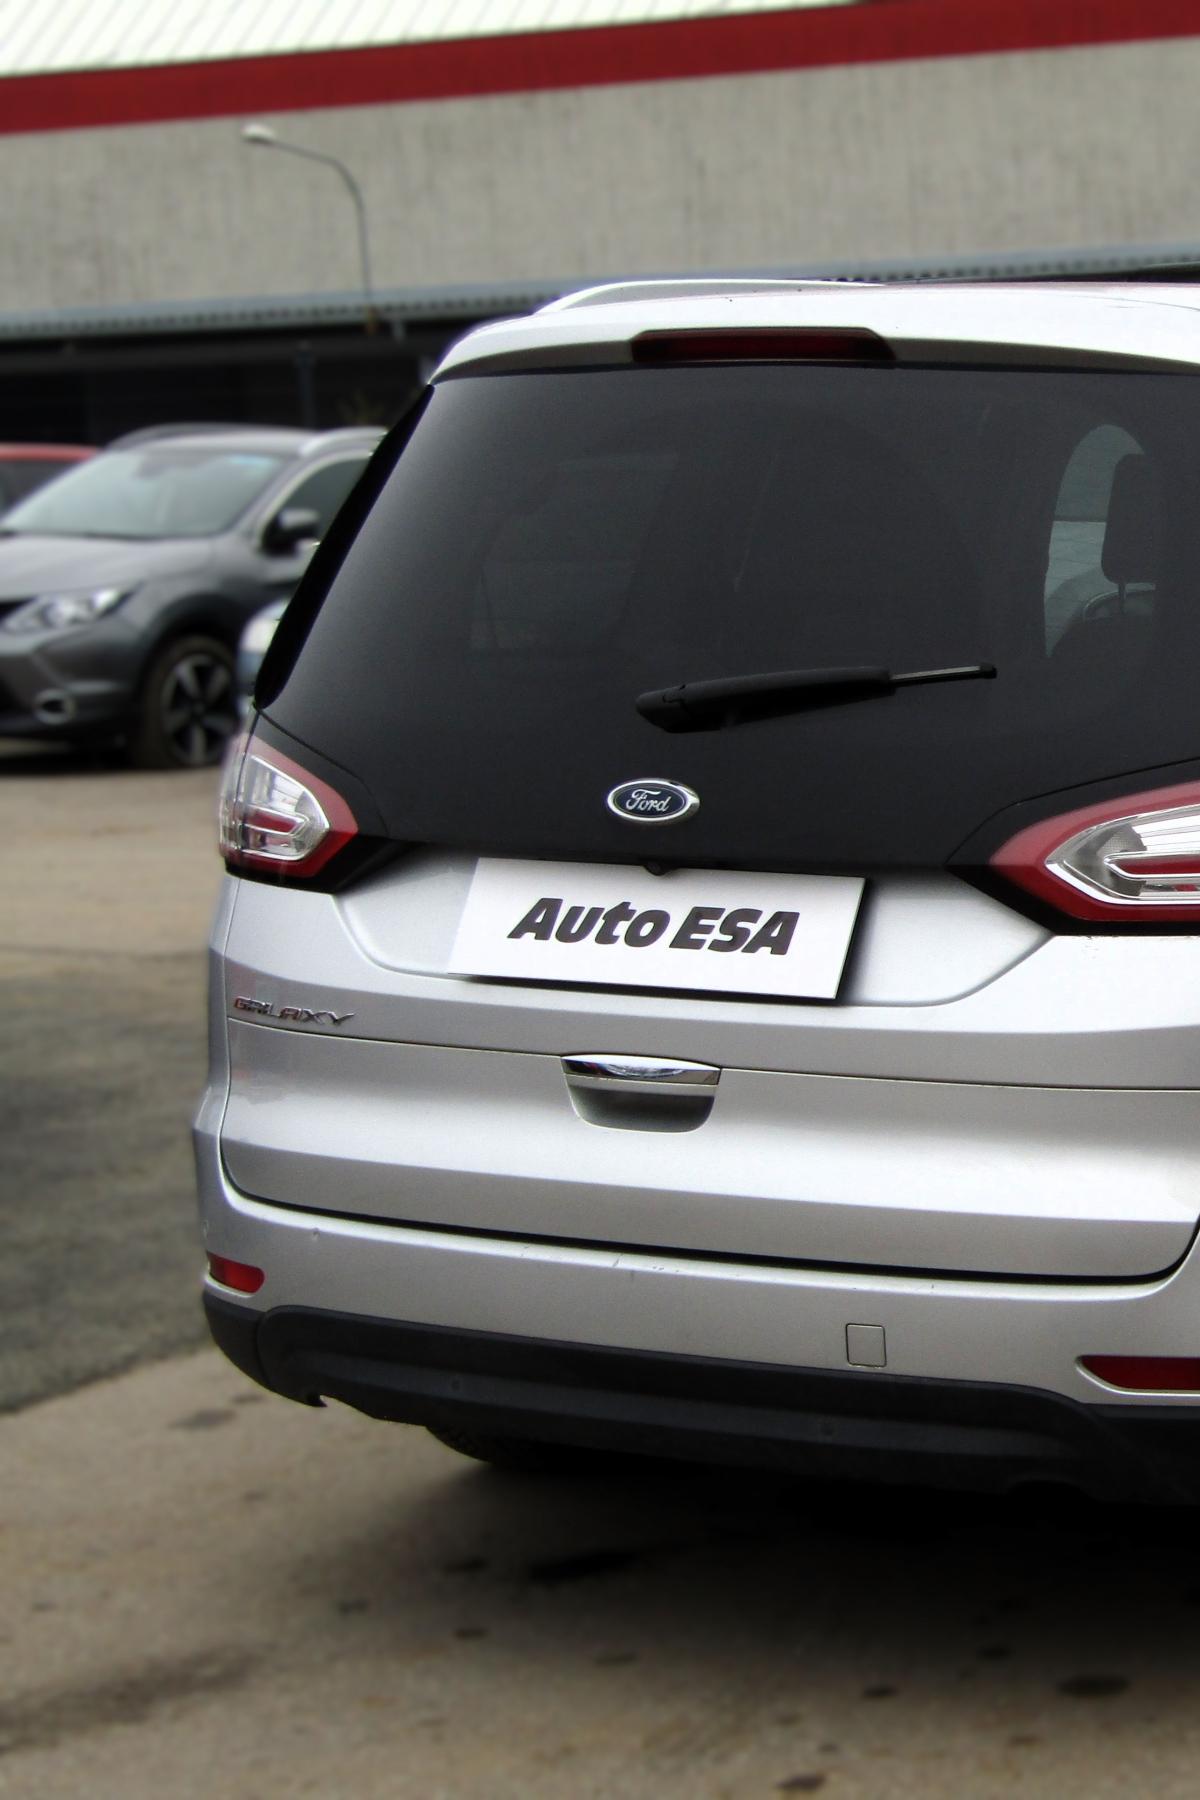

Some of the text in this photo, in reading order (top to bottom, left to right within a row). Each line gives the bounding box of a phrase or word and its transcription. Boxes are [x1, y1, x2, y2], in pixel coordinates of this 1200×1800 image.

[625, 788, 672, 812] Ford
[507, 897, 800, 956] Auto ESA
[234, 996, 356, 1025] GALAXY
